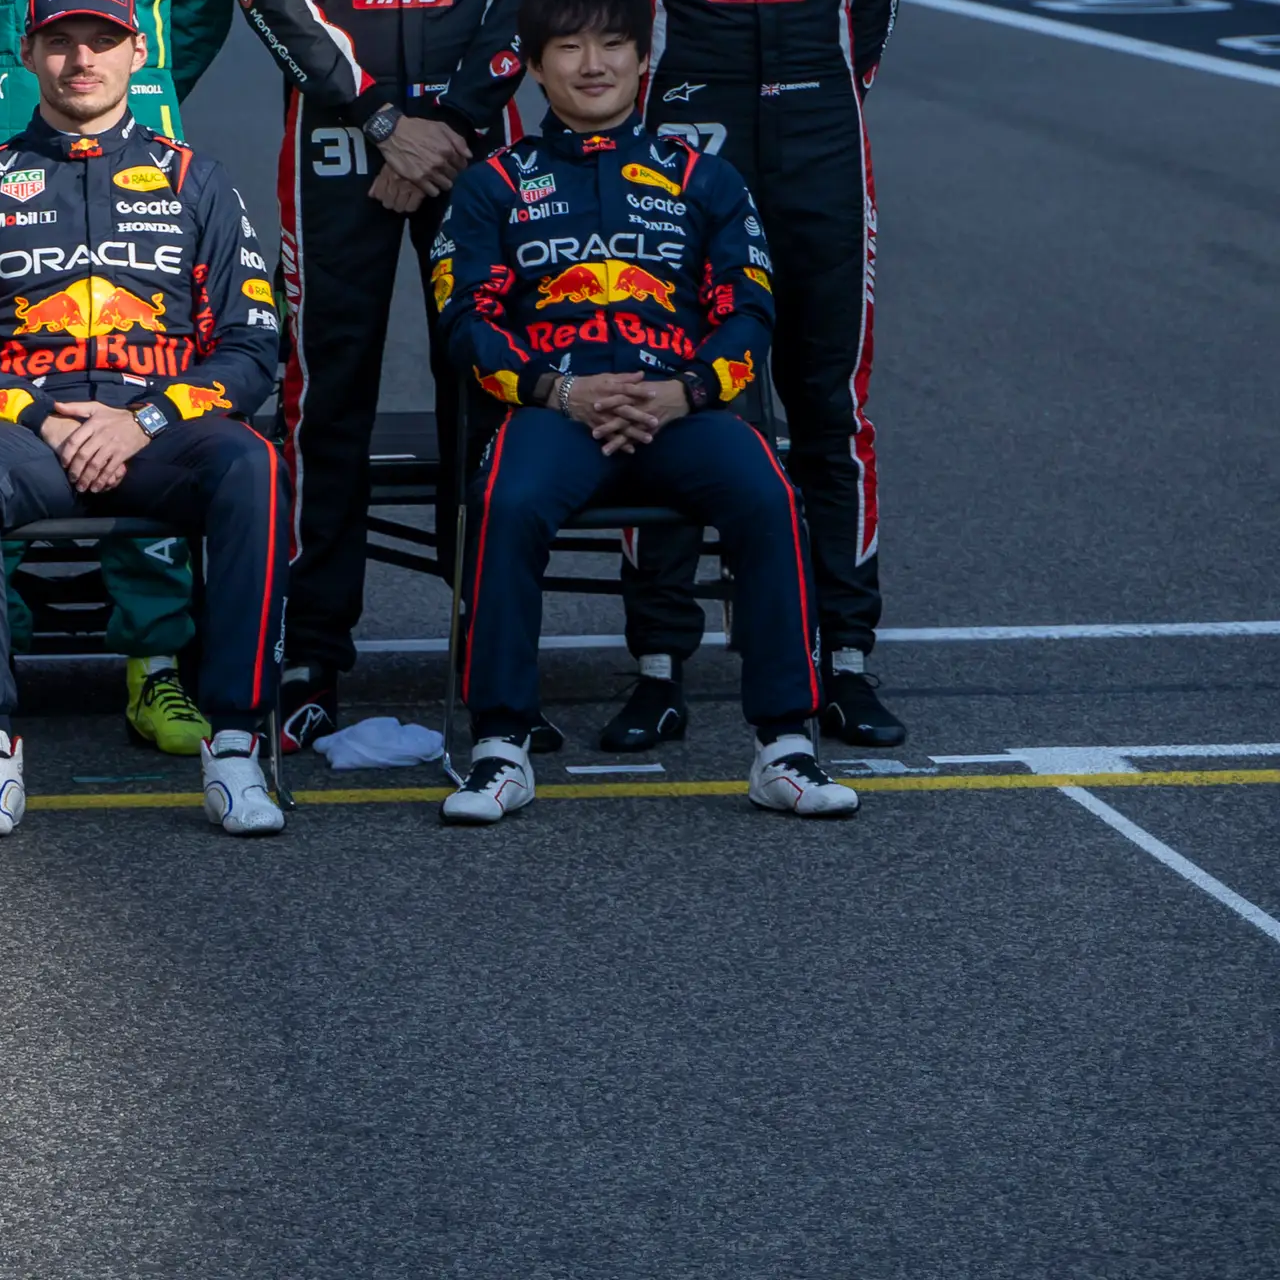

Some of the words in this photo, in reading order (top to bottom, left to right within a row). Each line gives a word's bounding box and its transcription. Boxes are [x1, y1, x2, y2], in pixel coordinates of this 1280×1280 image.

[250, 7, 309, 83] MoneyGram
[131, 85, 162, 95] STROLL
[312, 128, 369, 175] 31
[6, 173, 40, 182] TAG
[2, 183, 41, 197] HEUER
[509, 203, 550, 223] Mobil
[118, 223, 183, 233] HONDA
[629, 215, 686, 235] HONDA
[516, 234, 685, 269] ORACLE
[0, 339, 86, 375] Red
[96, 335, 193, 376] Bull
